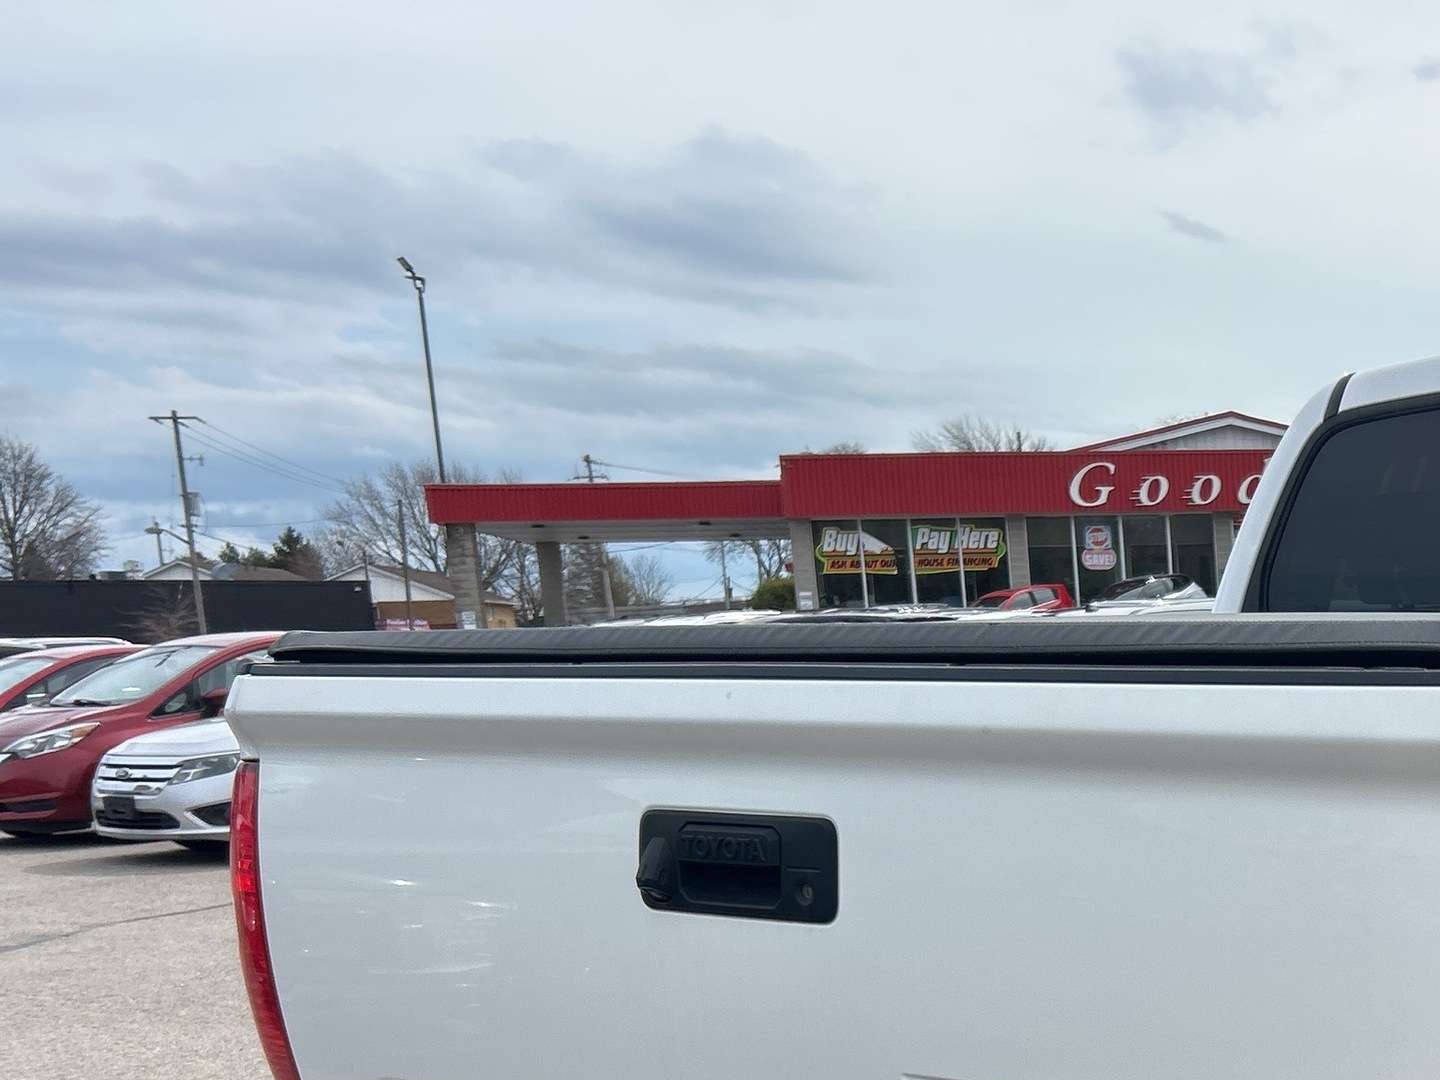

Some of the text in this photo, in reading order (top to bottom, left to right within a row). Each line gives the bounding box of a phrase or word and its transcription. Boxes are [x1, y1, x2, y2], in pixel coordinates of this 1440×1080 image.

[823, 529, 859, 556] Buy
[915, 527, 999, 554] Pay Here
[681, 835, 766, 862] TOYOTA
